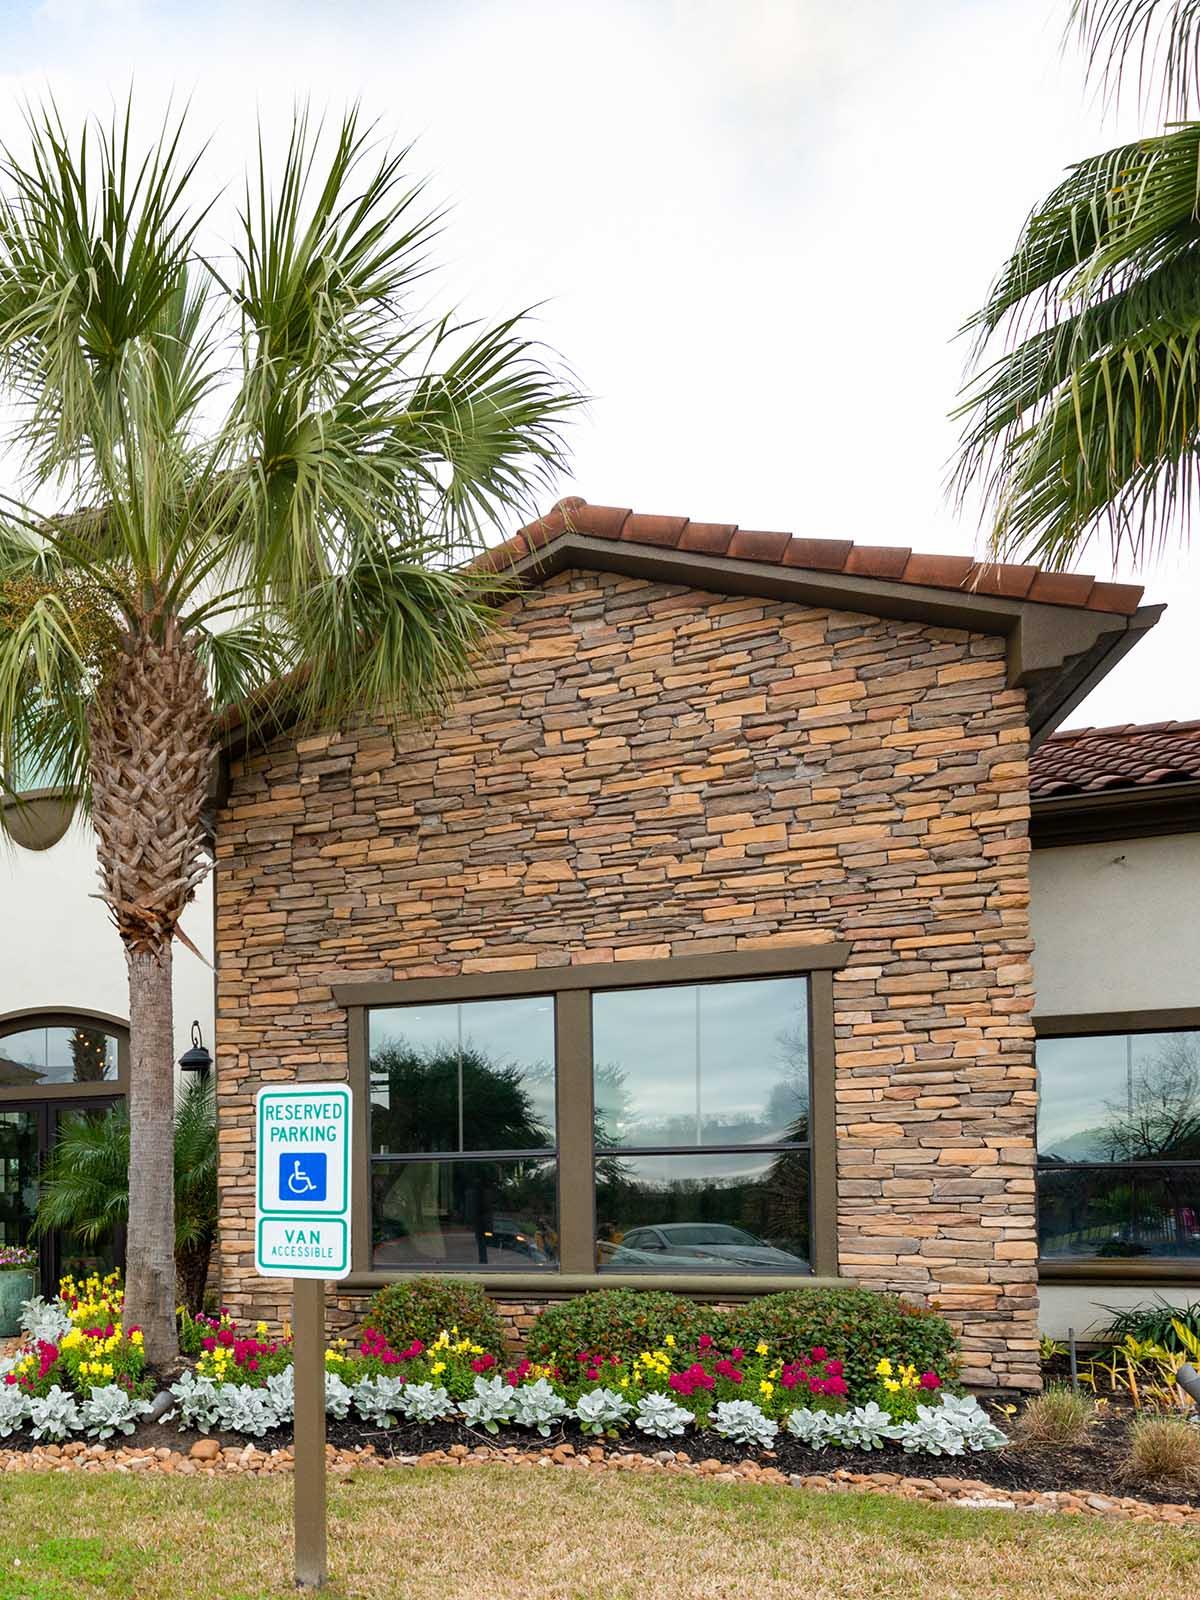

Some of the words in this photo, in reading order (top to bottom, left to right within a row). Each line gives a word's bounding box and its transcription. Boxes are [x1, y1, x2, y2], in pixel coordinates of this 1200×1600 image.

[266, 1104, 342, 1120] RESERVED
[271, 1126, 336, 1142] PARKING
[285, 1230, 320, 1244] VAN
[271, 1245, 333, 1258] ACCESSIBLE
